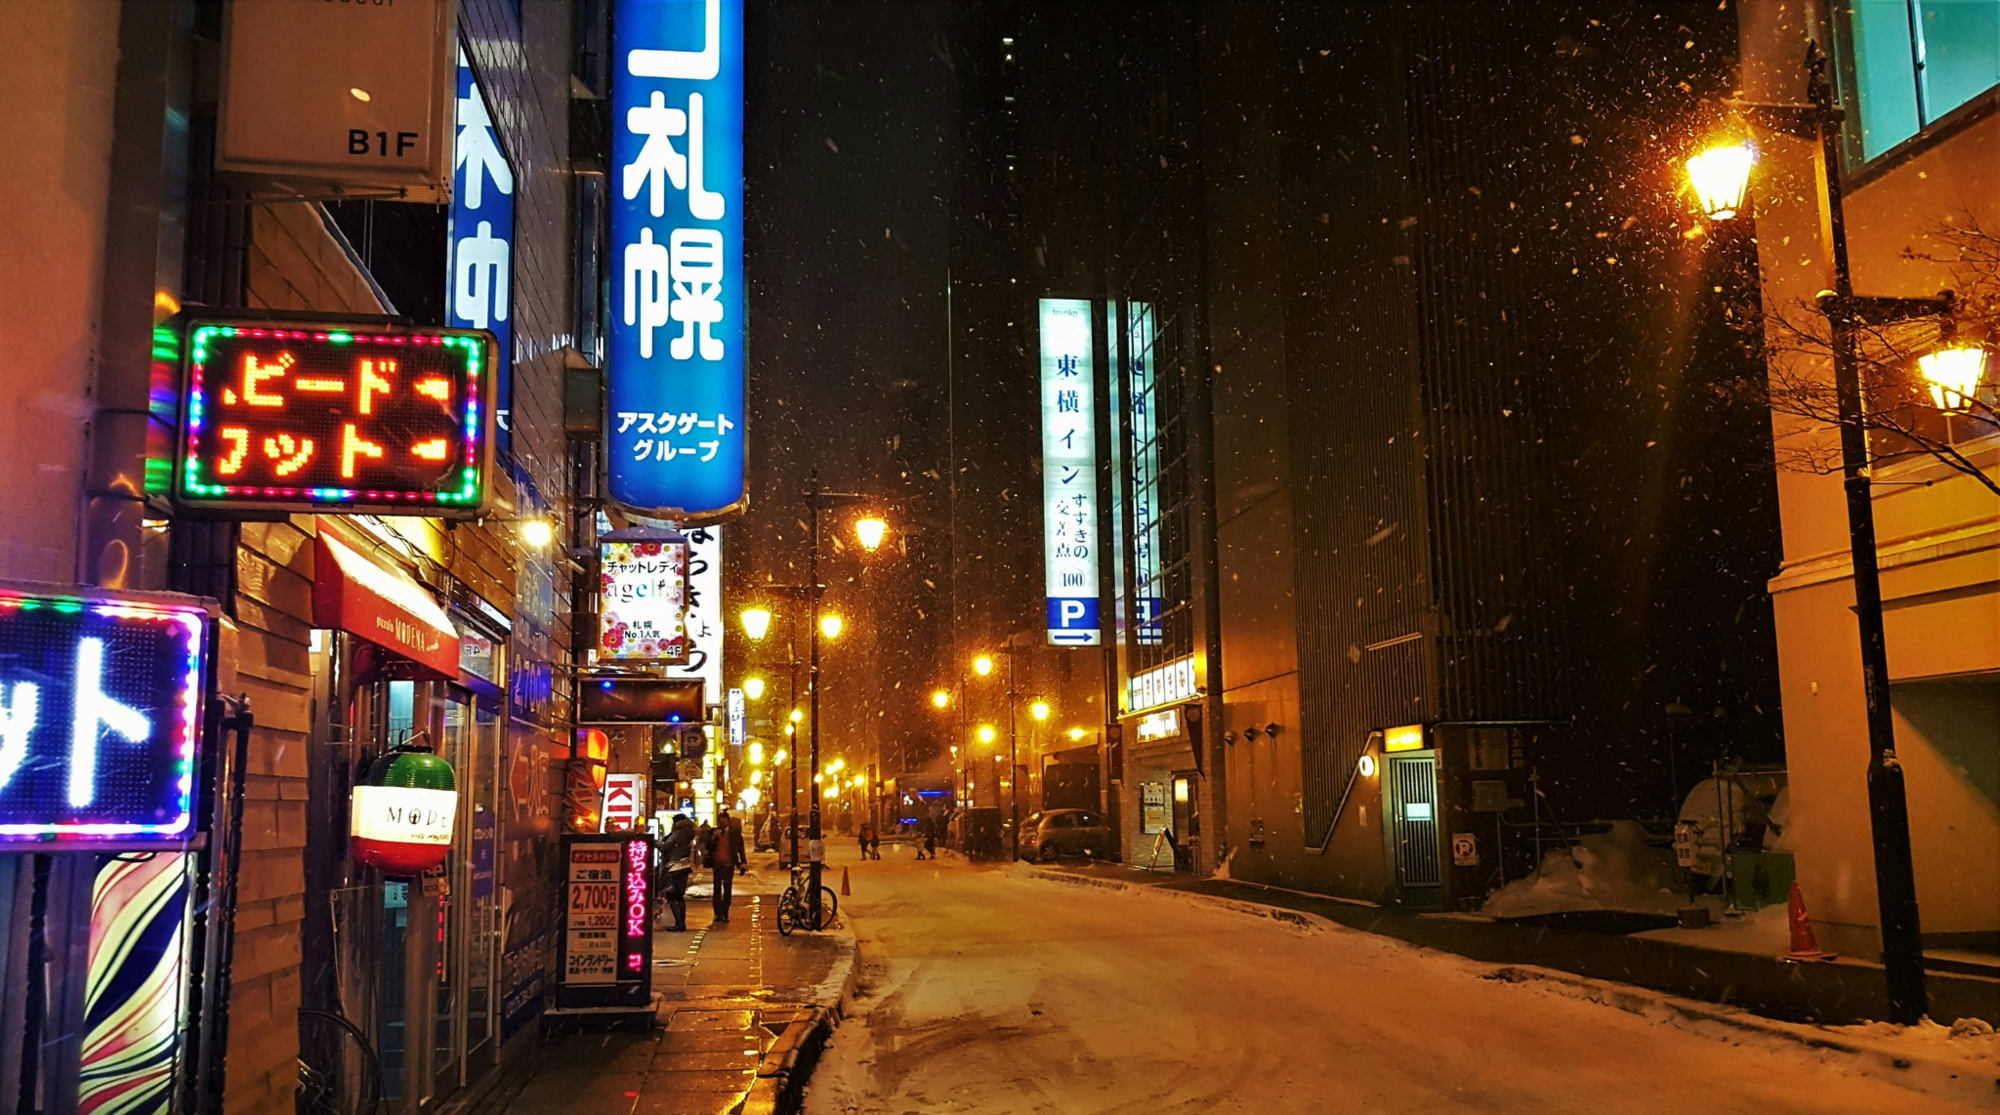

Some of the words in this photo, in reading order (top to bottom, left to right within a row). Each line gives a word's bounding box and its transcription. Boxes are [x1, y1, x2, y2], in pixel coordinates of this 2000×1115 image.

[348, 129, 418, 156] B1F
[617, 411, 735, 436] アスクゲート
[1055, 352, 1080, 484] 東横イン
[633, 438, 720, 463] グループ
[1071, 494, 1088, 559] すすきの
[606, 560, 679, 574] チャットレディ
[1062, 572, 1084, 588] 100
[1061, 600, 1086, 628] P
[395, 617, 425, 653] MODENA
[623, 630, 661, 639] No.1人気
[667, 645, 682, 657] 4F
[576, 869, 612, 880] ご宿泊
[627, 840, 648, 937] 持ち込みOK
